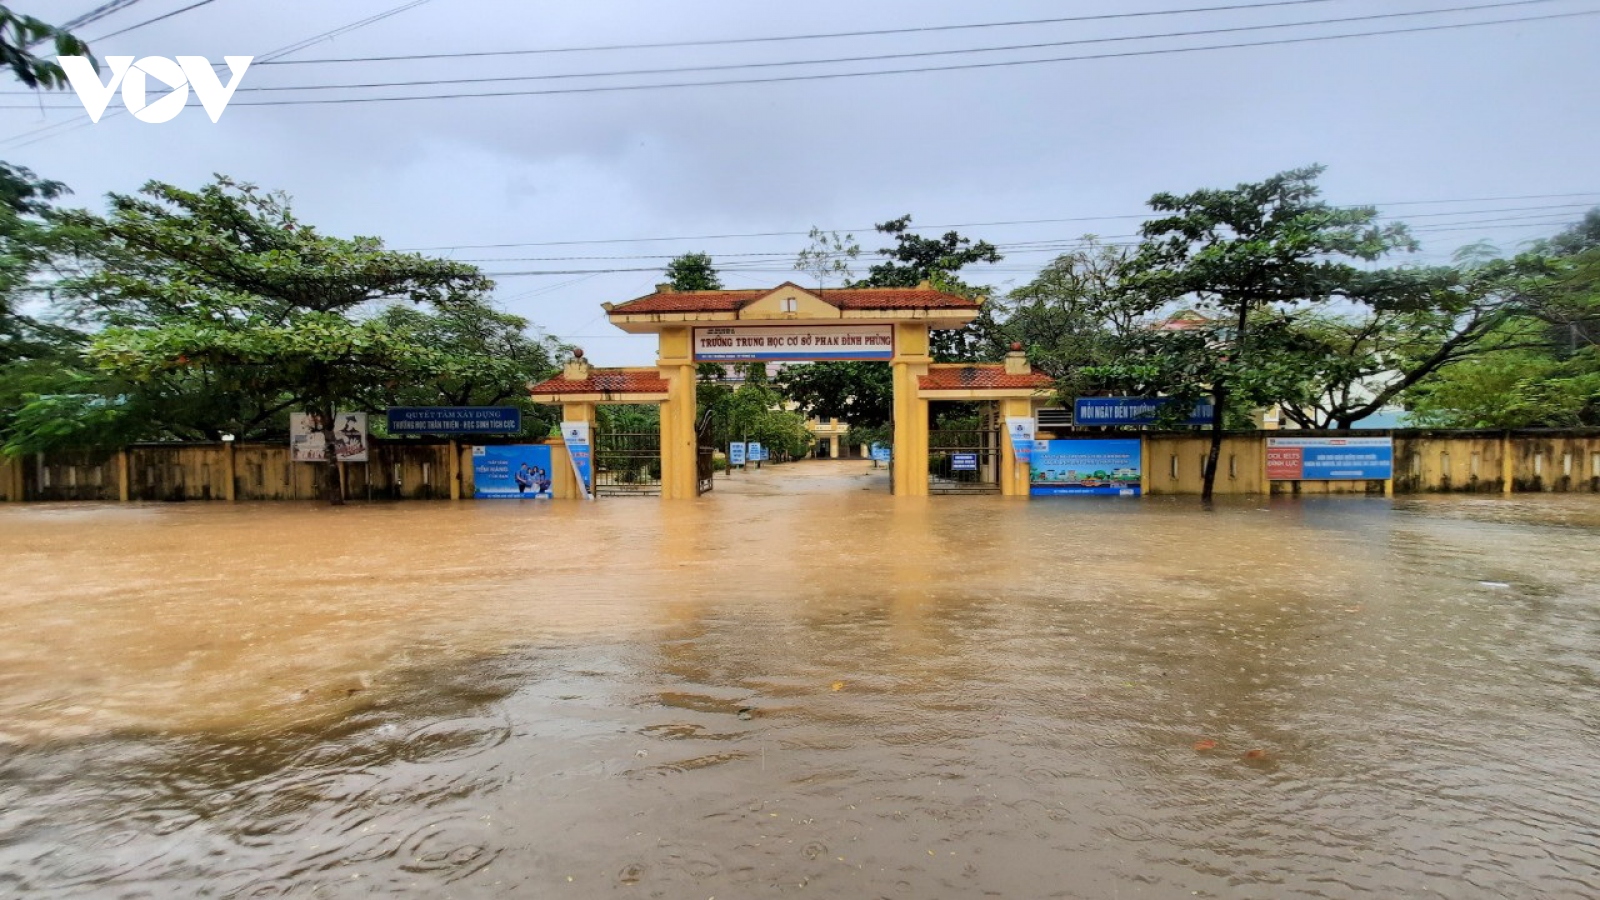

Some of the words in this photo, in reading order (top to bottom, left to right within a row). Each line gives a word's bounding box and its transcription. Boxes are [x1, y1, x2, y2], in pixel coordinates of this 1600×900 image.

[700, 334, 733, 347] TRƯỜNG
[735, 337, 765, 347] TRUNG
[767, 336, 785, 348] HỌC
[800, 333, 812, 346] SỞ
[814, 336, 840, 346] PHAN
[841, 333, 862, 346] ĐÌNH
[864, 333, 891, 346] PHÙNG
[405, 409, 435, 420] QUYẾT
[475, 410, 501, 420] DỰNG
